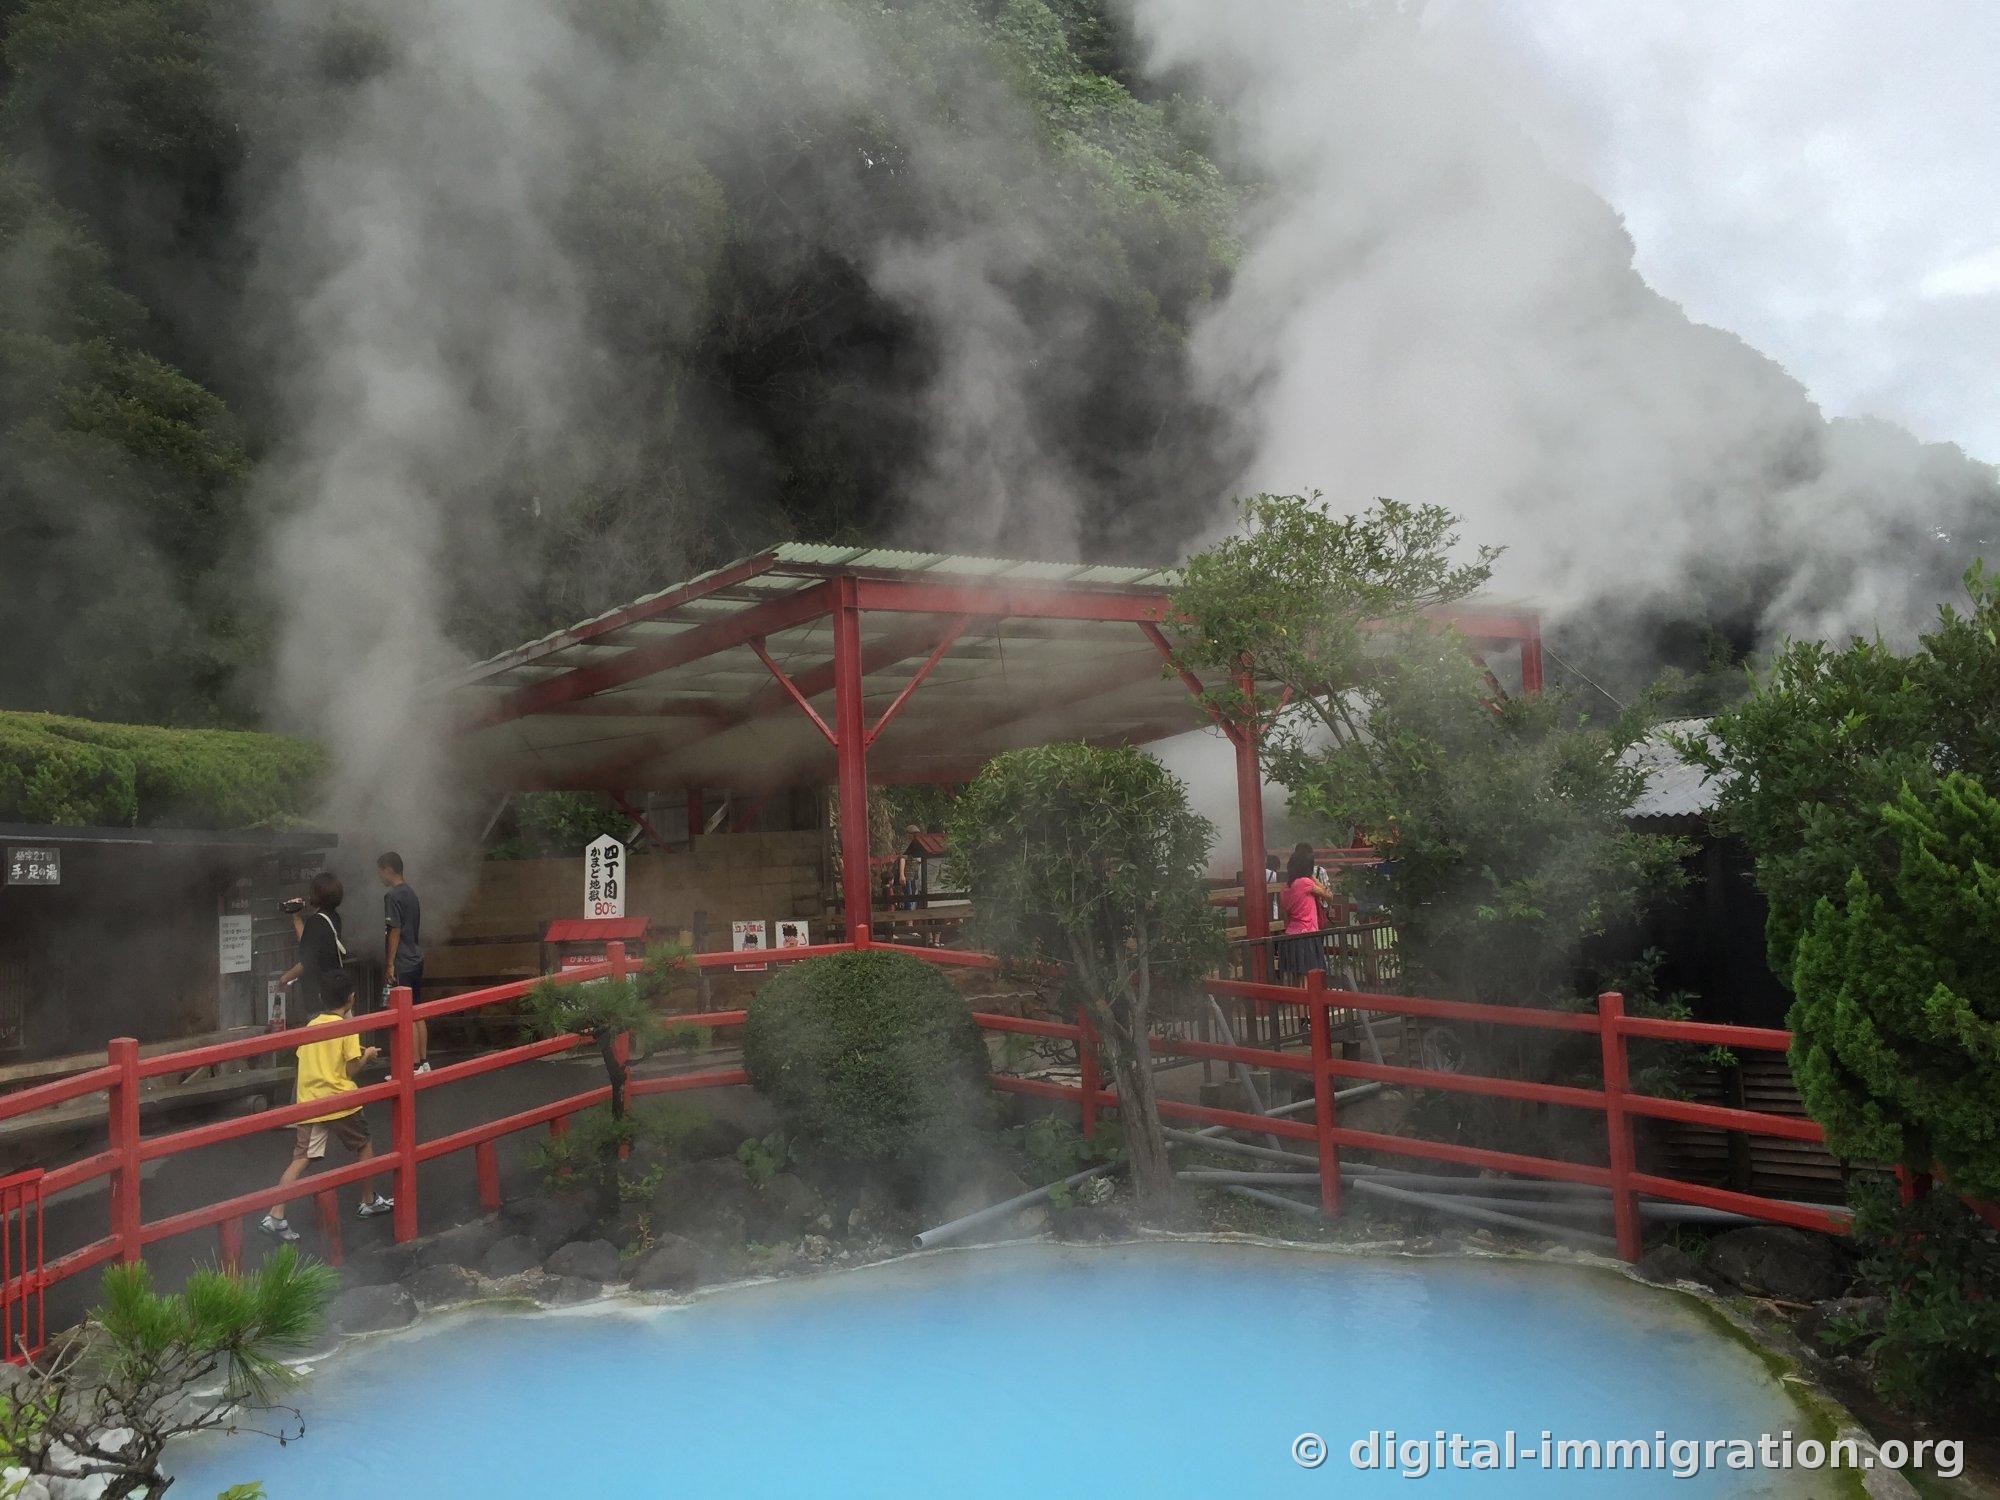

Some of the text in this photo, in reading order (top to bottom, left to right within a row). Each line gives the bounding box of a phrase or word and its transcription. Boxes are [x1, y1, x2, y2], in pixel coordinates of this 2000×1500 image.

[588, 847, 601, 902] かまど地獄
[604, 844, 619, 900] 四丁目
